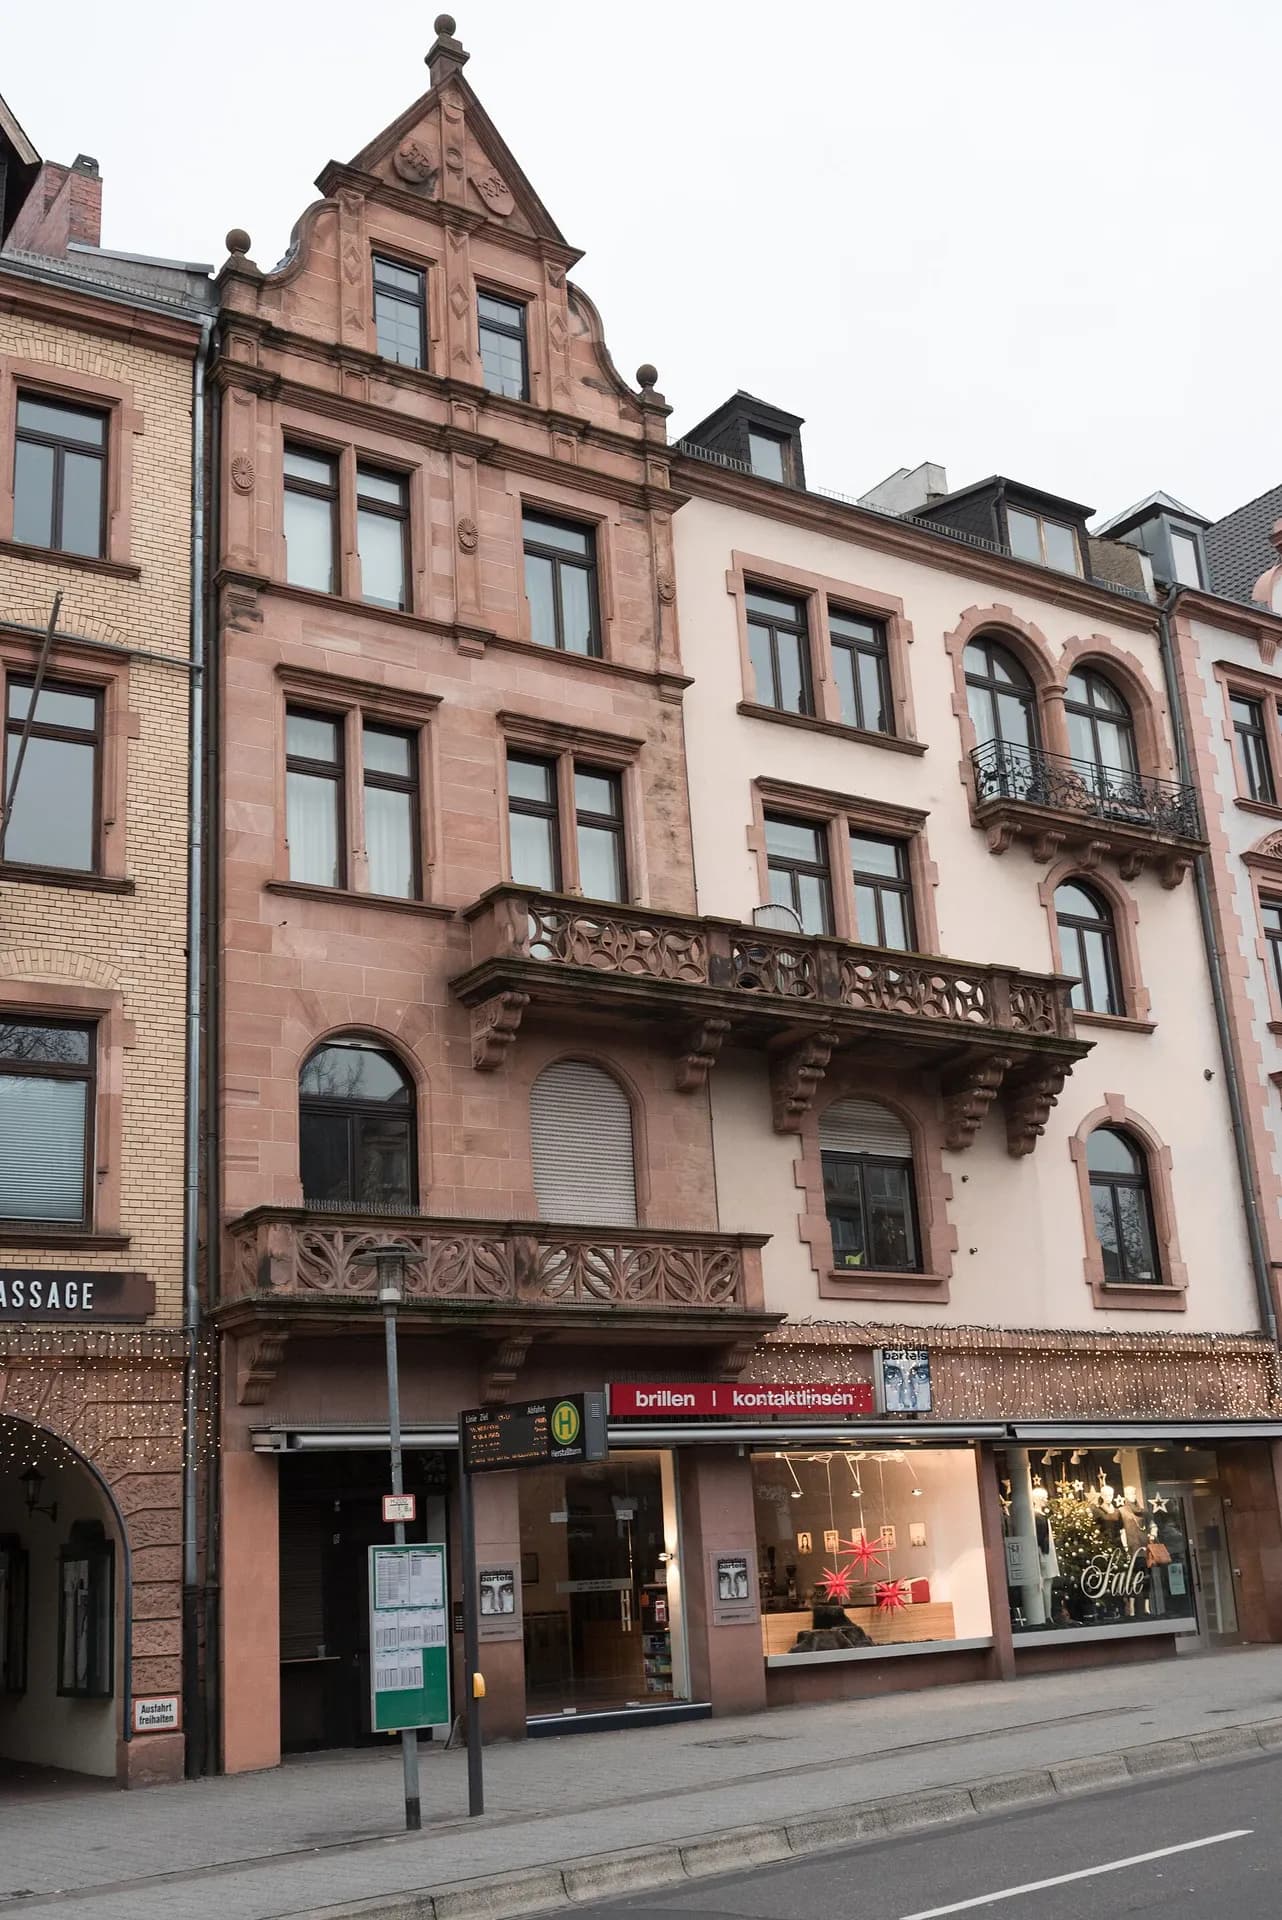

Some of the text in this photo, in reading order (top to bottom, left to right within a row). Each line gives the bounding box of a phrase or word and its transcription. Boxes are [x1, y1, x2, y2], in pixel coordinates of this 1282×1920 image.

[882, 1342, 928, 1351] christian
[883, 1347, 928, 1360] bartels
[635, 1389, 854, 1407] brillen kontaktlinsen
[559, 1410, 572, 1436] H
[1081, 1547, 1146, 1598] Sale
[141, 1704, 172, 1713] Ausfahrt
[139, 1715, 174, 1725] freihalten
